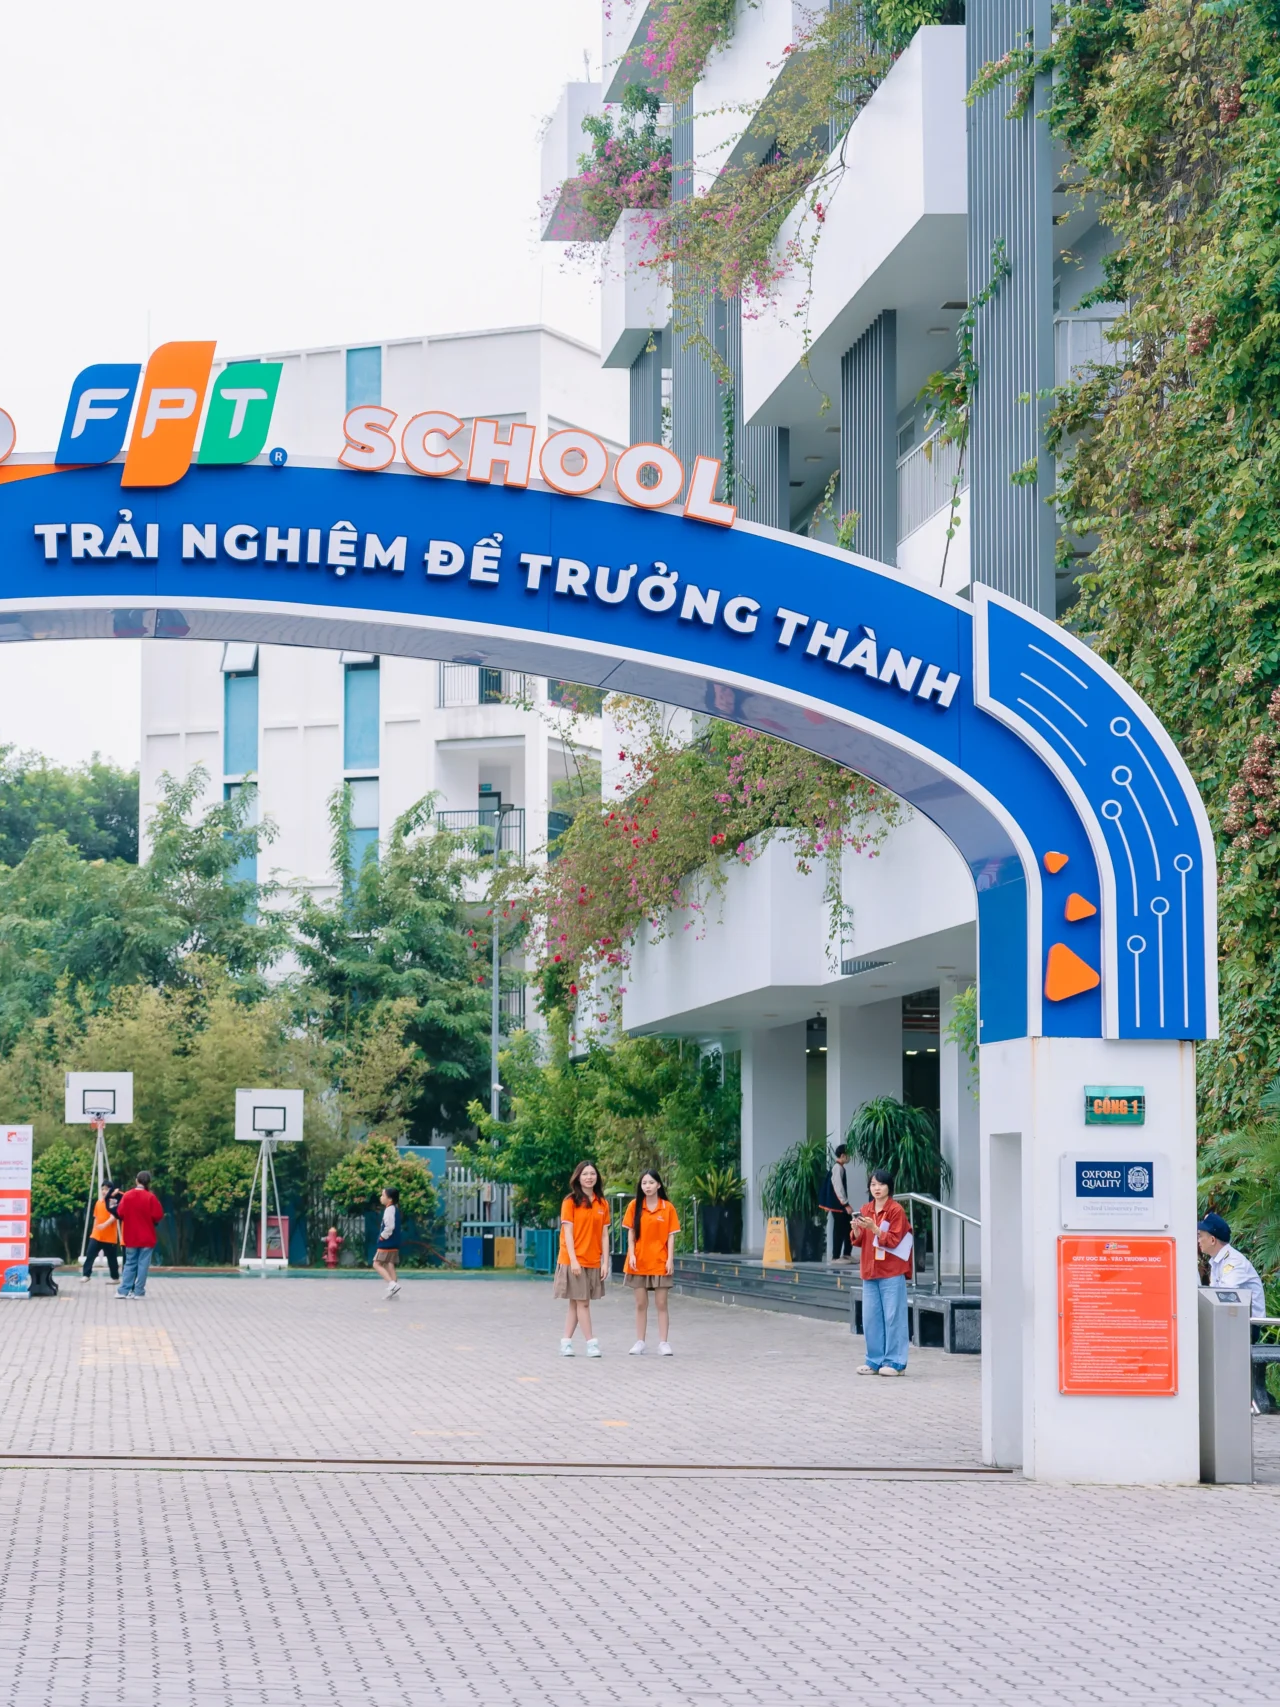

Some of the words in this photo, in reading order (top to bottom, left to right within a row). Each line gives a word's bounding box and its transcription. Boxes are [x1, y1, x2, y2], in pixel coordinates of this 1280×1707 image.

[338, 404, 737, 528] SCHOOL
[34, 509, 159, 559] TRẢI
[182, 520, 408, 577] NGHIỆM
[424, 532, 504, 584] ĐỂ
[520, 561, 761, 633] TRƯỞNG
[776, 607, 961, 707] THÀNH
[1131, 1099, 1138, 1115] 1
[1081, 1170, 1121, 1179] OXFORD
[1081, 1179, 1121, 1189] QUALITY
